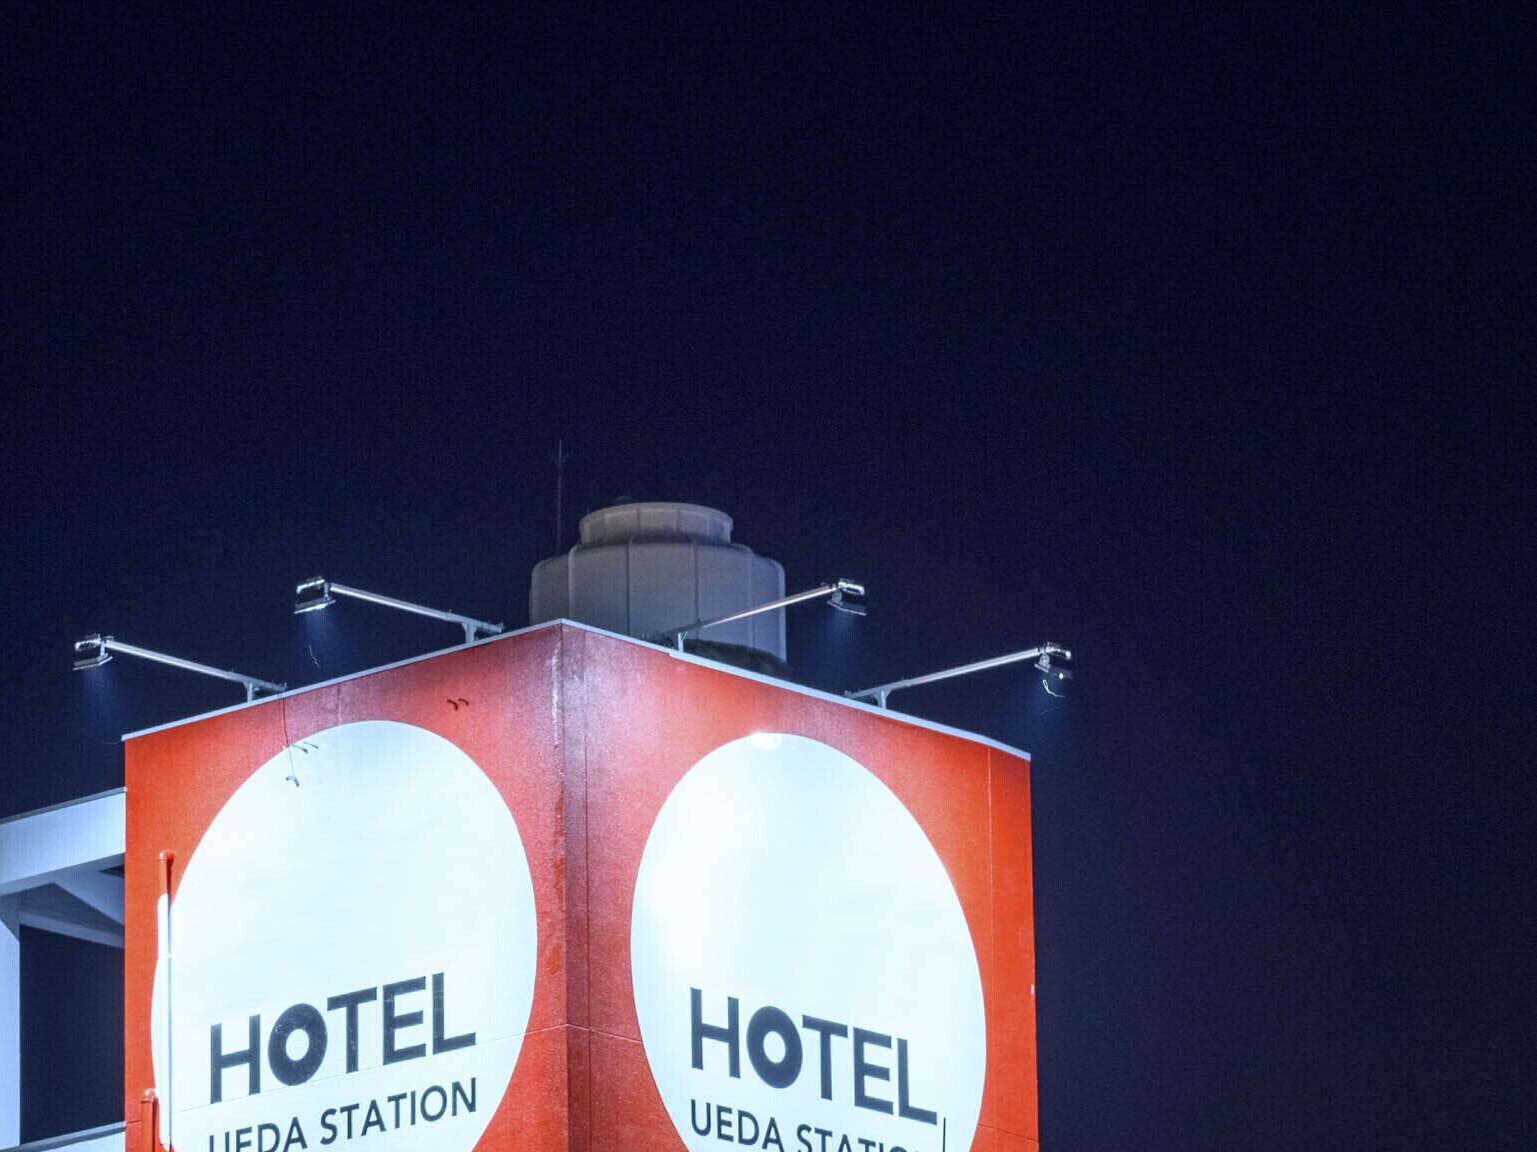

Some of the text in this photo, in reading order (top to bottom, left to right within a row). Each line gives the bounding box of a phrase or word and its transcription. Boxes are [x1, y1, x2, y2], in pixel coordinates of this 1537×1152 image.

[210, 972, 476, 1105] HOTEL
[690, 986, 938, 1126] HOTEL
[320, 1077, 477, 1145] STATION
